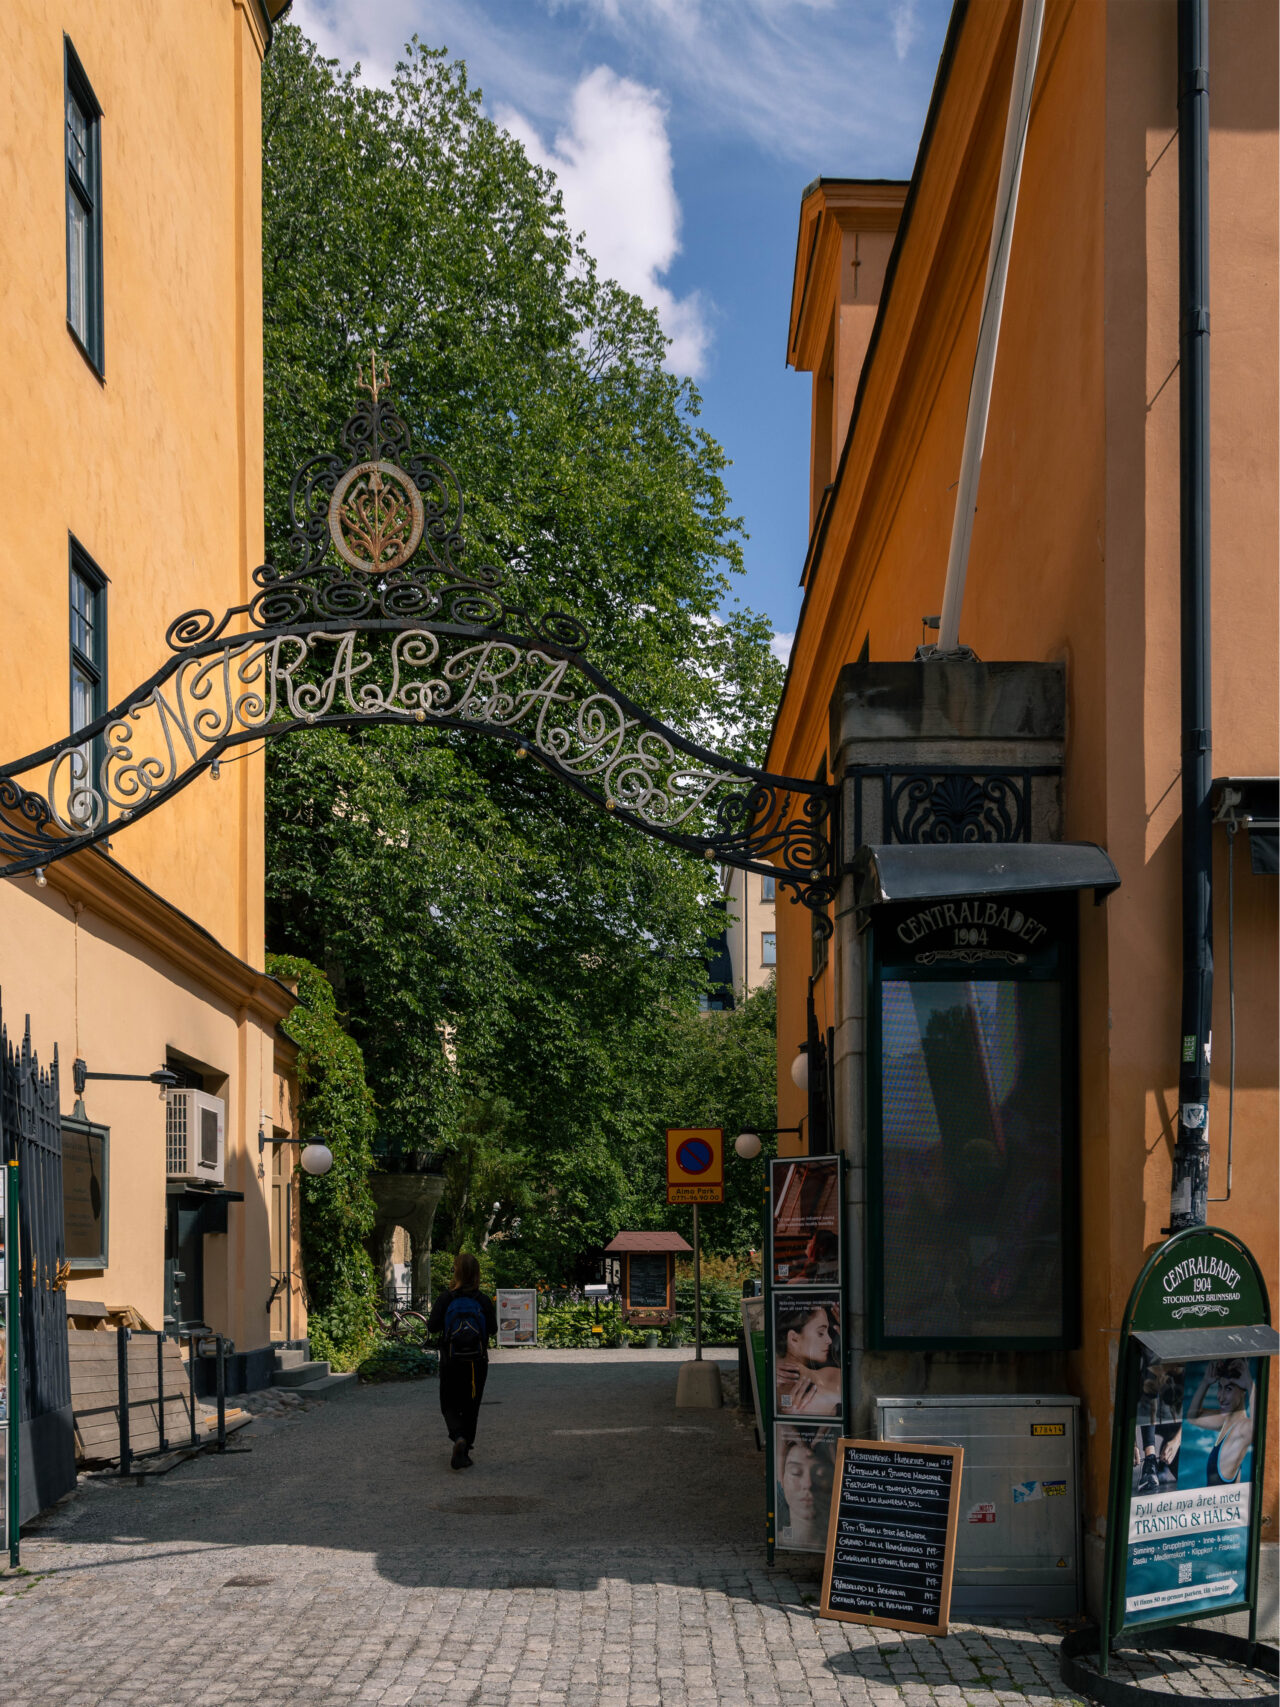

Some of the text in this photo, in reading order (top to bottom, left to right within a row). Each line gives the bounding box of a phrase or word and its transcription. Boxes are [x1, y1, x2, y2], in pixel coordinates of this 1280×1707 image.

[48, 629, 753, 838] CENTRALBADET
[896, 901, 1048, 944] CENTRALBADET
[954, 927, 990, 946] 1904
[1163, 1256, 1241, 1292] CENTRALBADET
[1193, 1277, 1212, 1292] 1904
[1162, 1292, 1241, 1304] STOCKHOLMS BRUNNSBAD
[1135, 1490, 1241, 1518] Fyll det nya året med
[1135, 1506, 1241, 1535] TRÄNING & HÄLSA
[1133, 1545, 1155, 1556] Simning
[1162, 1540, 1196, 1551] Gruppträning
